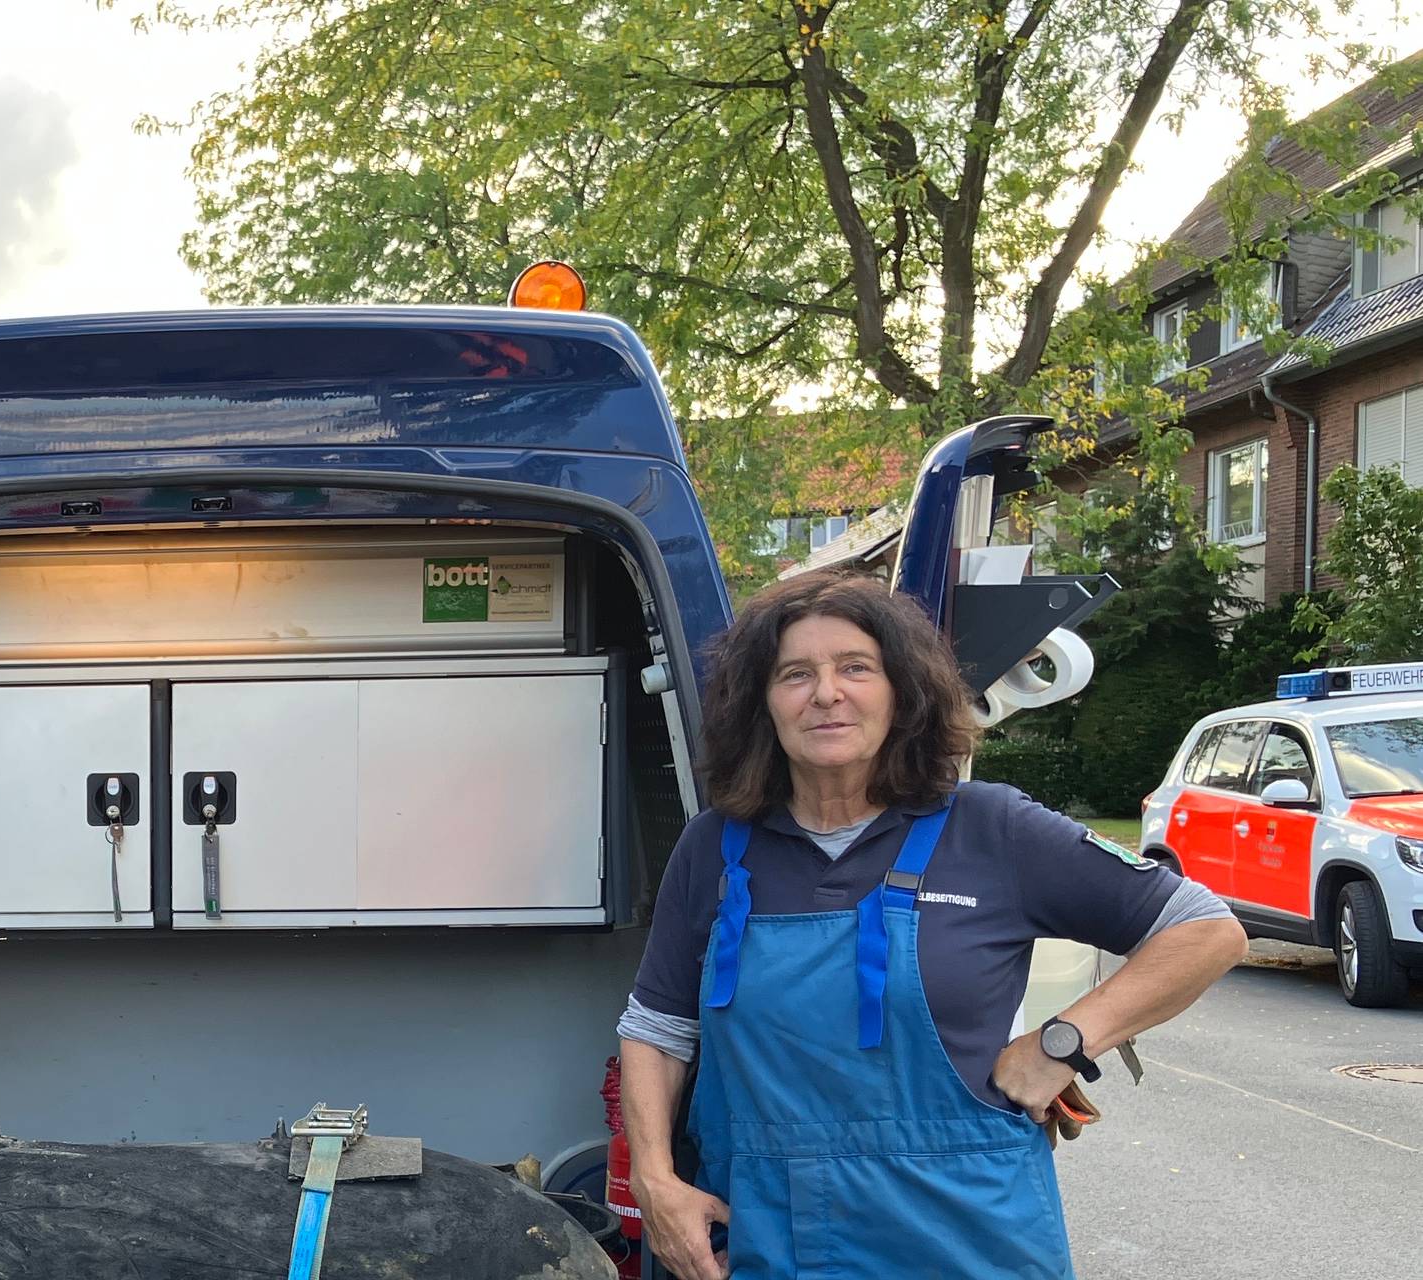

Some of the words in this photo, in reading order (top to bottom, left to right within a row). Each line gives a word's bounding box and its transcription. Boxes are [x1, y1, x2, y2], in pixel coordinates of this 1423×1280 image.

[427, 562, 489, 587] bott
[918, 891, 977, 908] ELBESEITIGUNG
[608, 1201, 642, 1219] MINIMA
